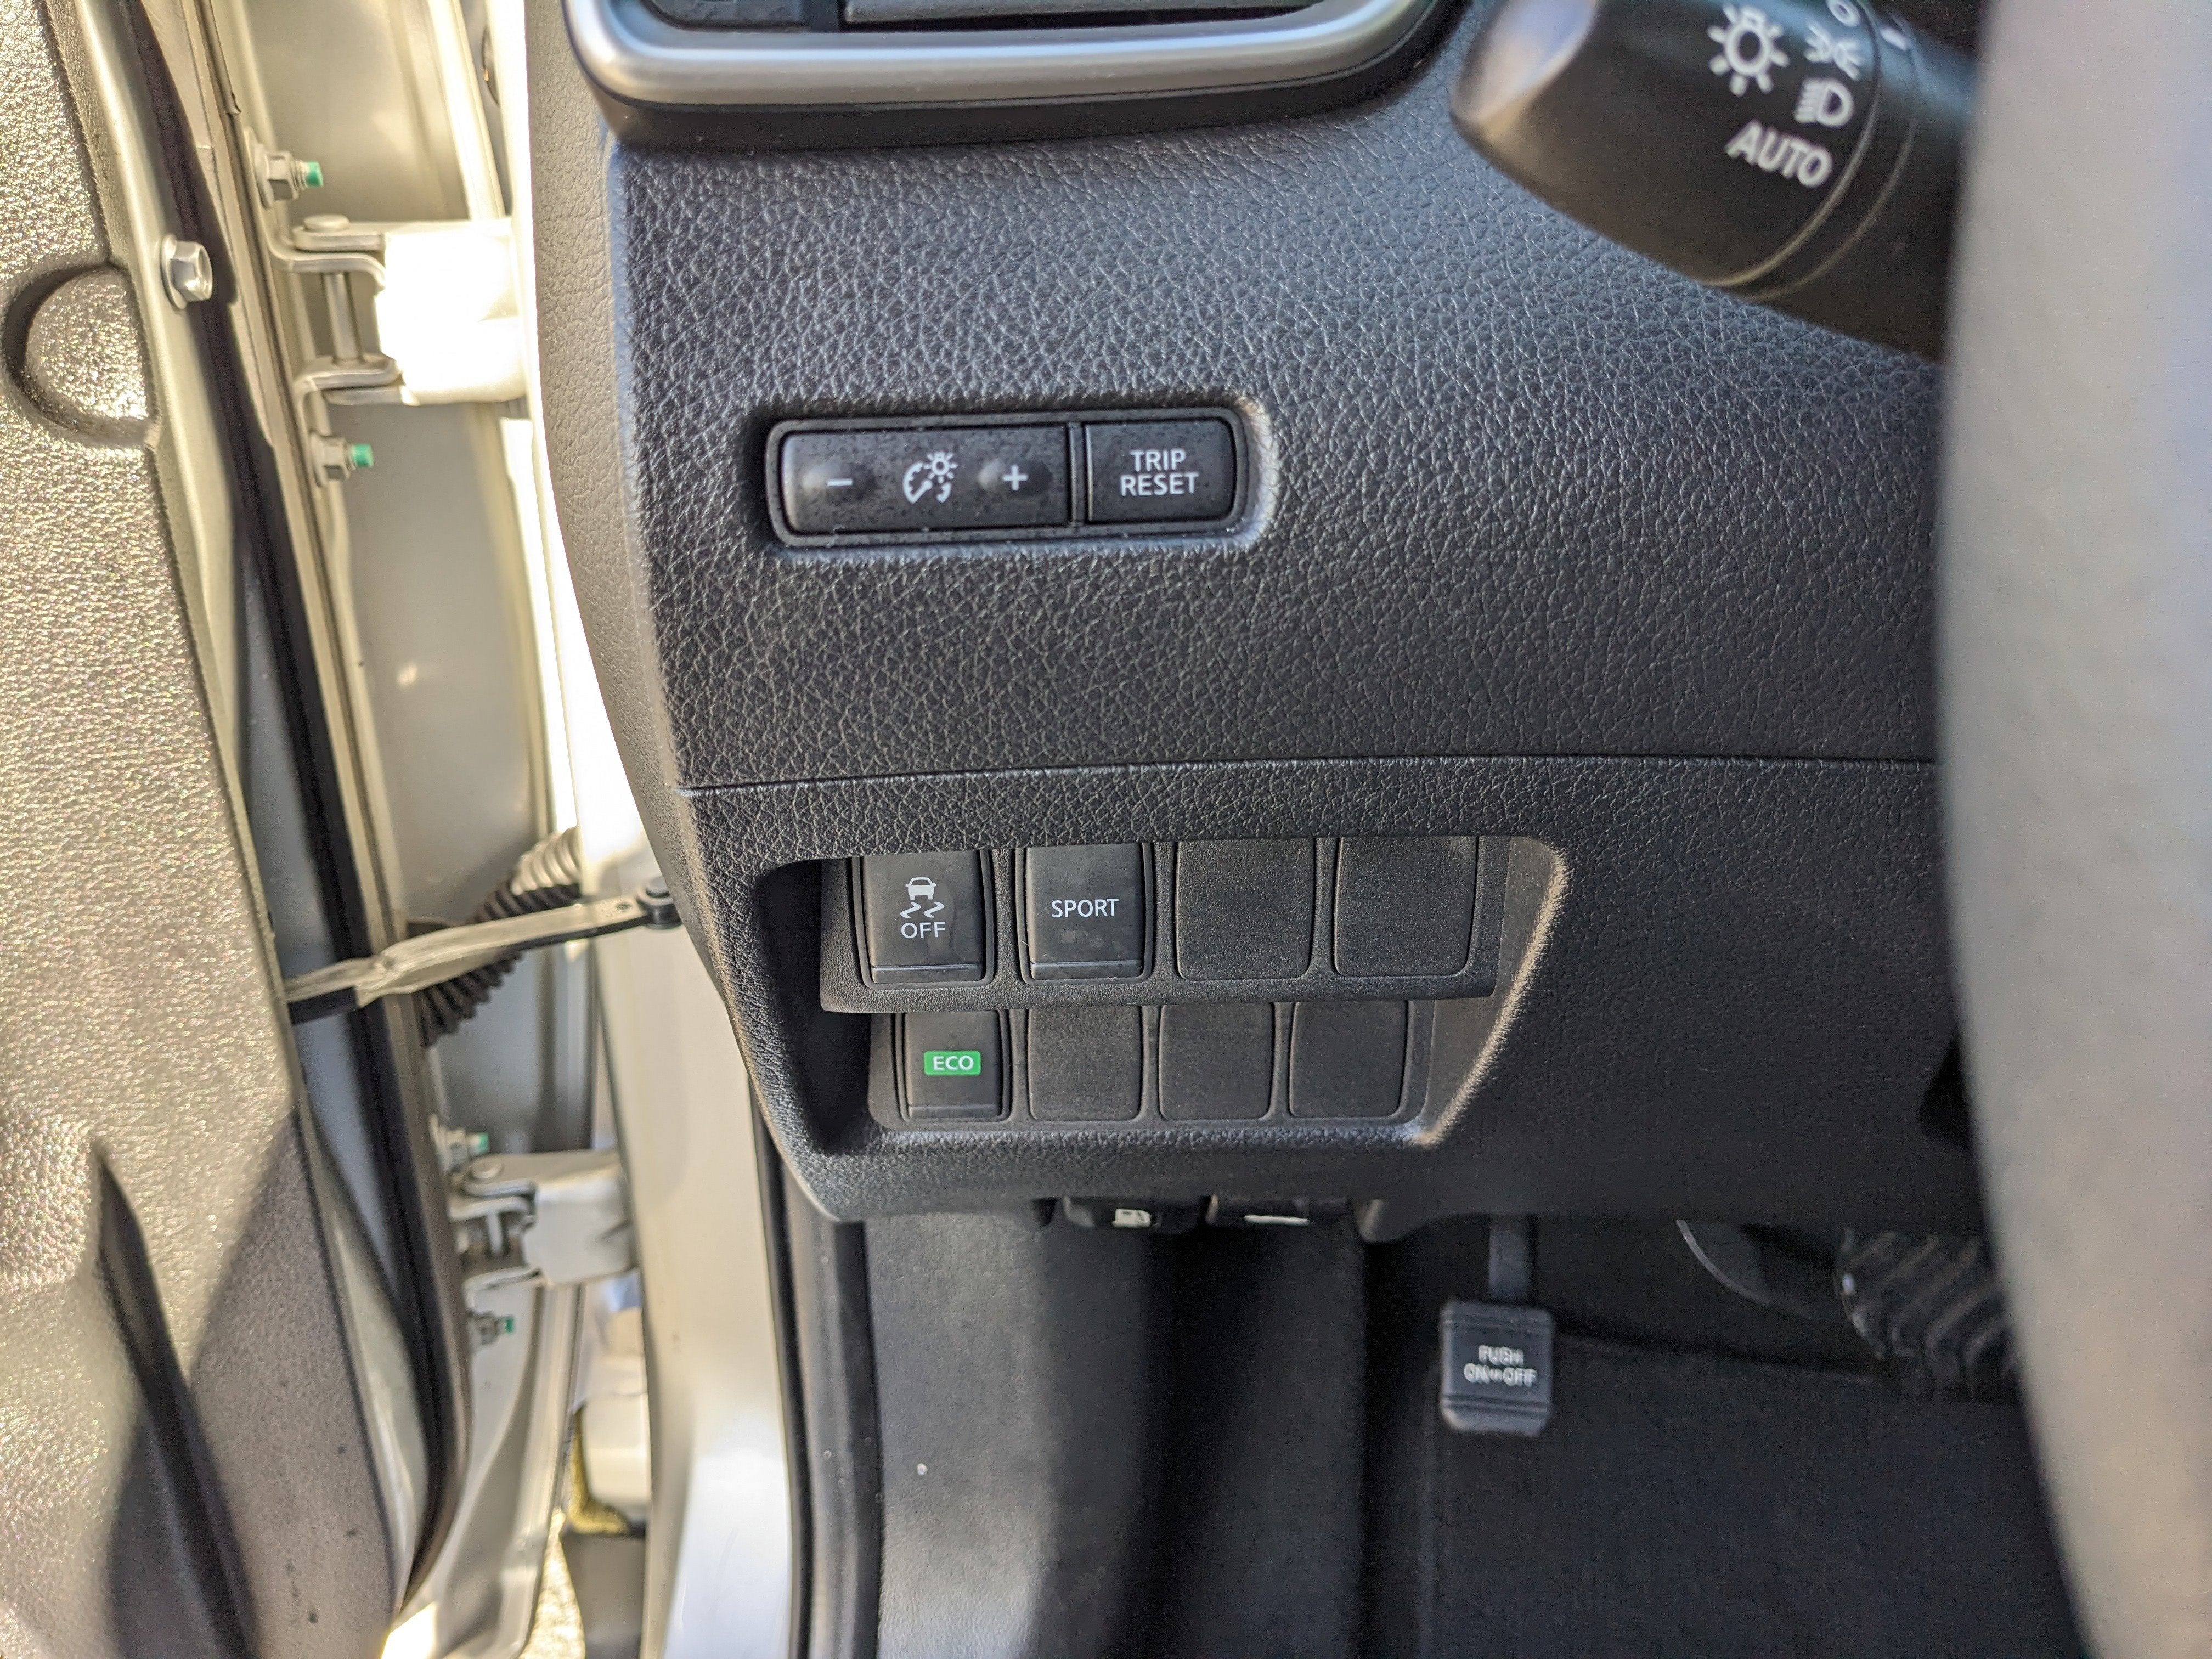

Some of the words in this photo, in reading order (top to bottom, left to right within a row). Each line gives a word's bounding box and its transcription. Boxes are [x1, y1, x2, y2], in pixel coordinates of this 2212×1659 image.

[1724, 120, 1833, 187] AUTO
[1130, 448, 1187, 472] TRIP
[1120, 471, 1199, 496] RESET
[1051, 898, 1119, 918] SPORT
[900, 921, 946, 939] OFF
[932, 1055, 974, 1071] ECO
[1478, 1344, 1525, 1367] PUSH
